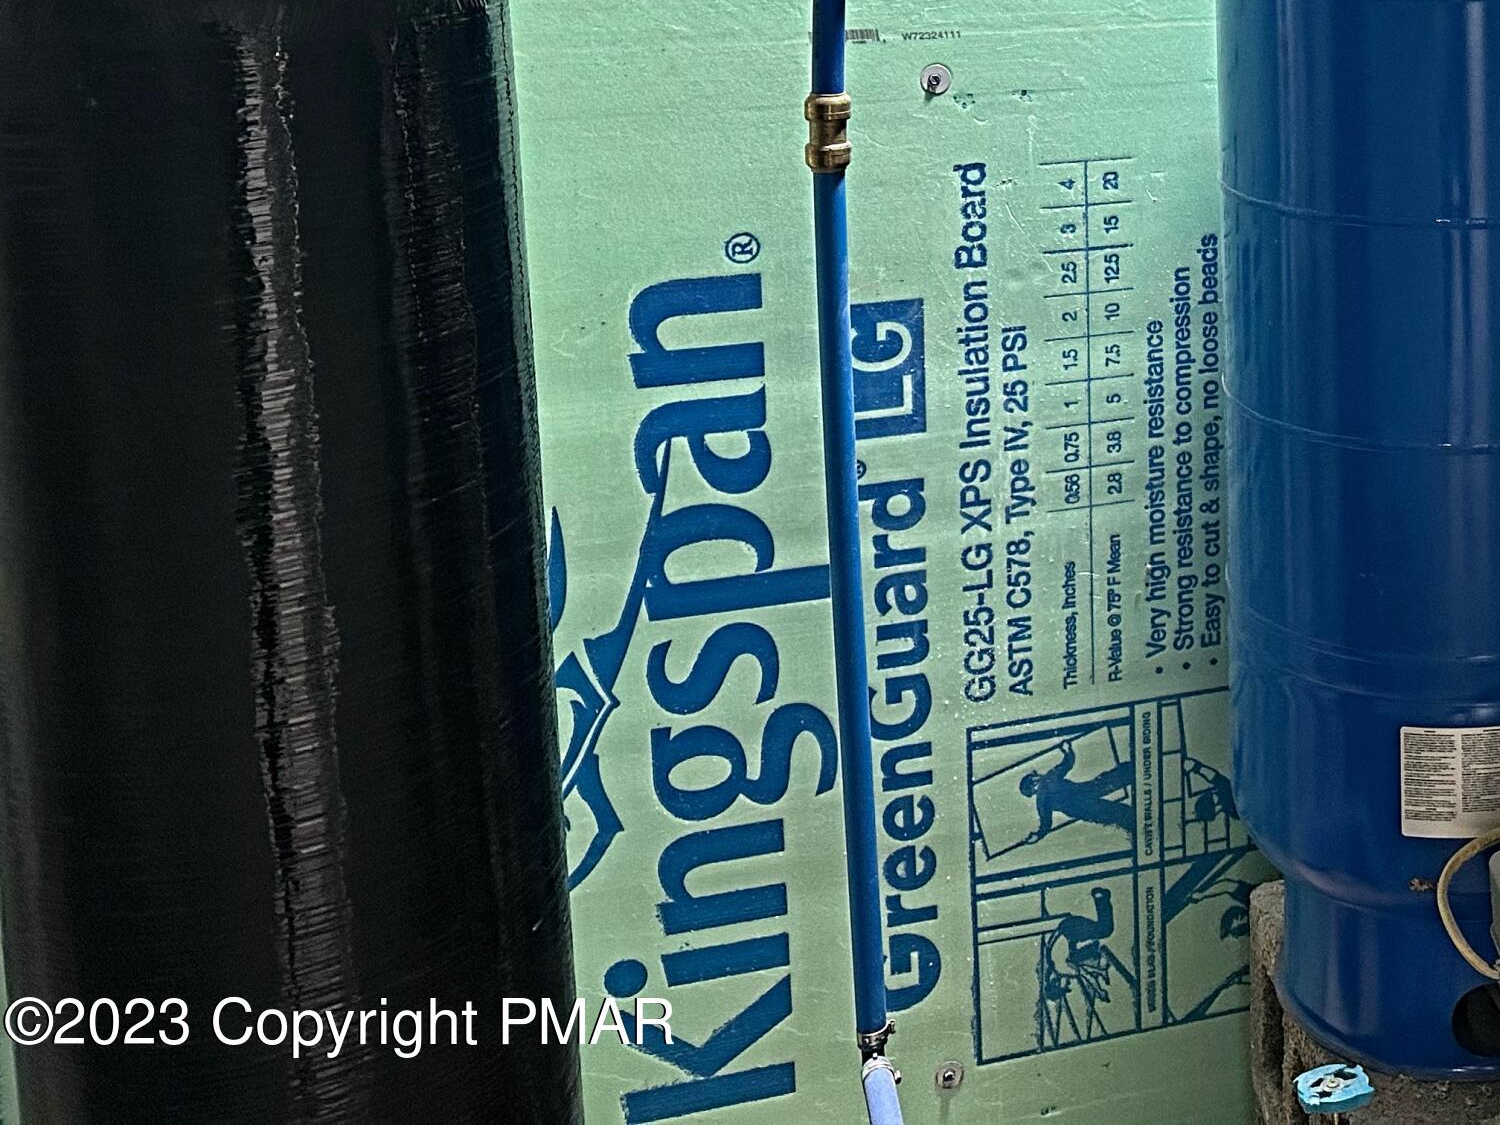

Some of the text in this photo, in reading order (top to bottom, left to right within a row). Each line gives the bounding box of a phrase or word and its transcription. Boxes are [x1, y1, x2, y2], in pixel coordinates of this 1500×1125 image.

[902, 30, 961, 40] W72324111
[1058, 179, 1076, 189] 4
[1060, 224, 1076, 234] 3
[1061, 262, 1077, 283] 2.5
[1062, 311, 1077, 321] 2
[850, 322, 920, 417] LG
[1062, 349, 1078, 371] 1.5
[953, 162, 996, 703] GG25-LG XPS Insulation Board
[1064, 432, 1080, 463] 0.75
[1103, 172, 1123, 681] R-Value Mean 2.8 3.8 5 7.5 10 12.5 15 20
[1197, 233, 1225, 647] Easy to cut & shape, no loose beads
[1170, 267, 1197, 650] Strong resistance to compression
[1001, 325, 1037, 696] ASTM C578, Type IV, 25 PSI
[1064, 474, 1080, 504] 0.56
[1144, 320, 1170, 658] Very high moisture resistance
[1062, 612, 1078, 689] Thickness,
